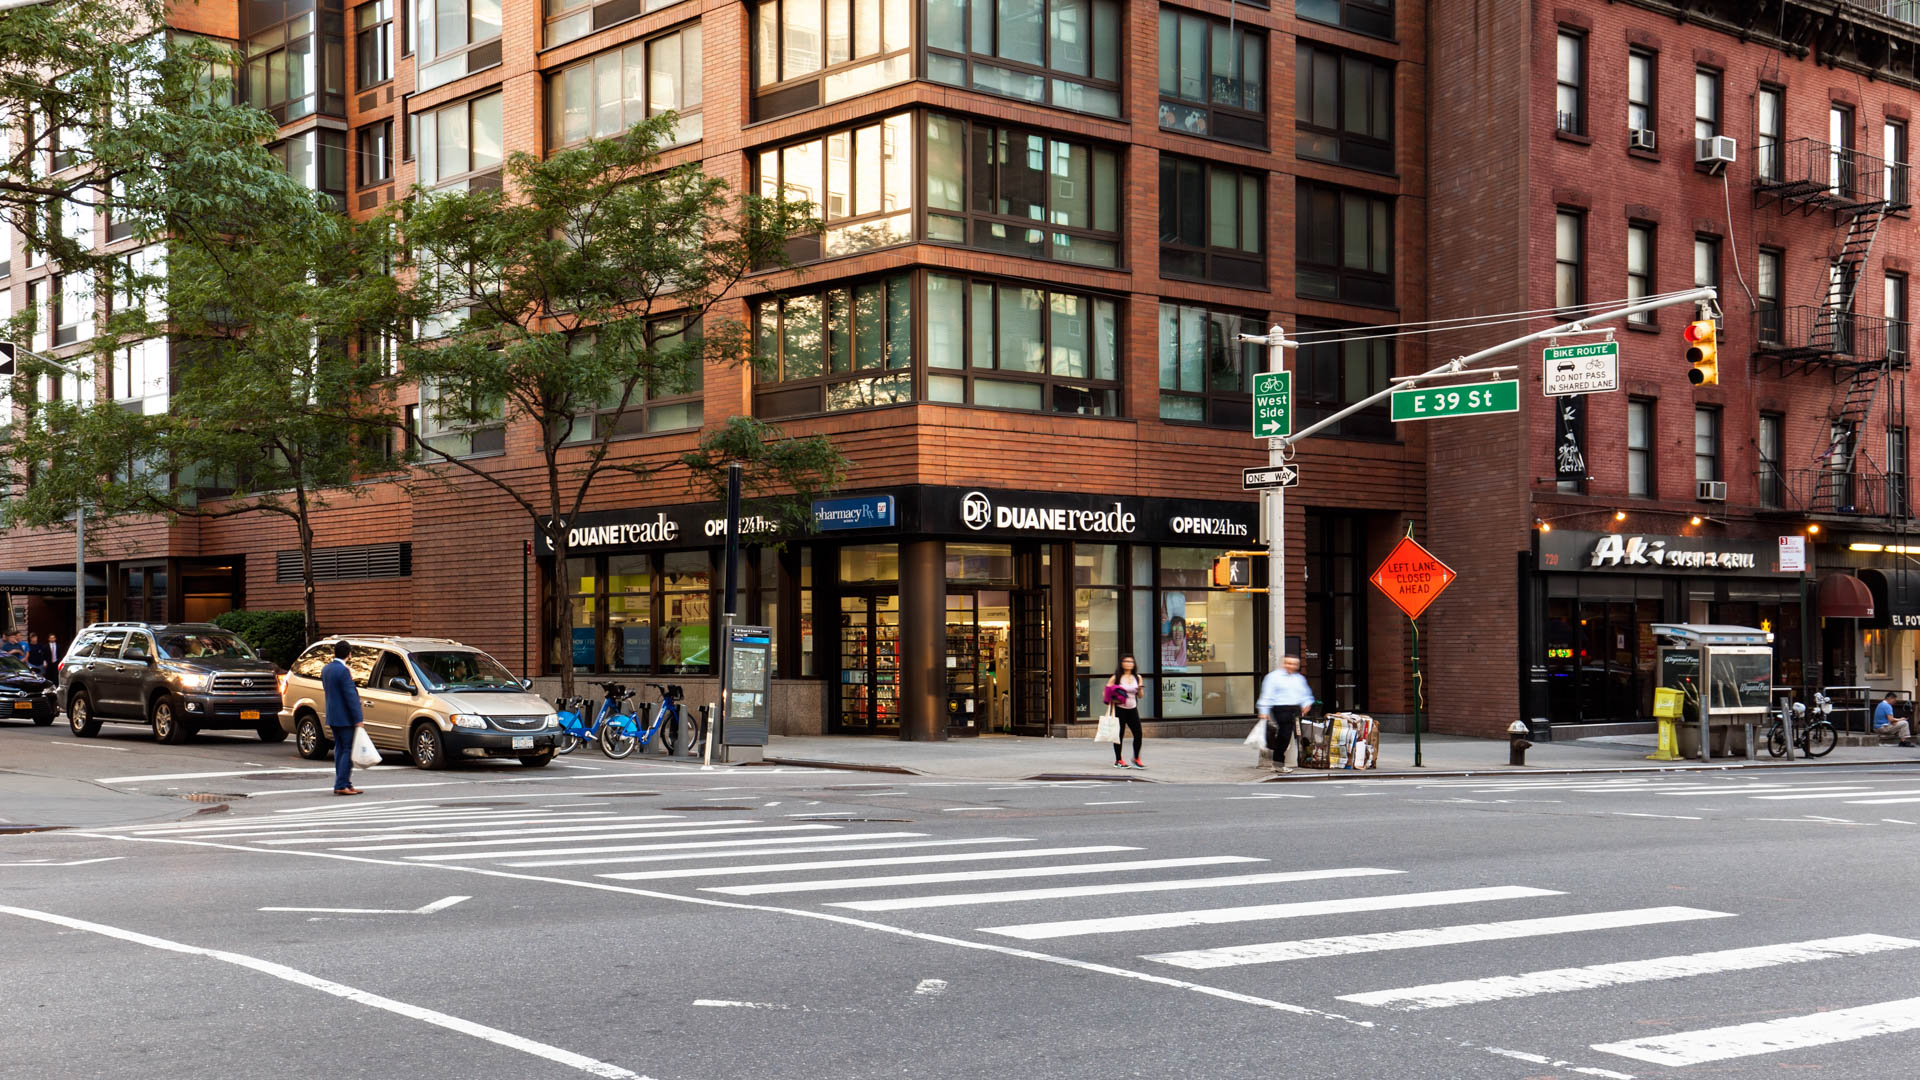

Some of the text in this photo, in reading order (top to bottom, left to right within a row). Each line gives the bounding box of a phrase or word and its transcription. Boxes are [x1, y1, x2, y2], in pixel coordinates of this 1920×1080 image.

[1553, 344, 1608, 358] BIKE ROUTE
[1555, 371, 1606, 382] DO NOT PASS
[1558, 381, 1590, 391] SHARED
[1592, 379, 1613, 389] LANE
[1257, 394, 1287, 407] West
[1414, 390, 1493, 413] E 39 St
[1259, 407, 1284, 419] Side
[1247, 471, 1292, 483] ONE WAY
[815, 507, 862, 523] pharmacy
[1591, 534, 1667, 567] Aki
[1670, 550, 1705, 568] SUSHI
[1723, 552, 1755, 569] GRILL
[1388, 561, 1437, 573] LEFT LANE
[1396, 572, 1431, 584] CLOSED
[1400, 584, 1430, 594] AHEAD
[1892, 615, 1904, 626] EL
